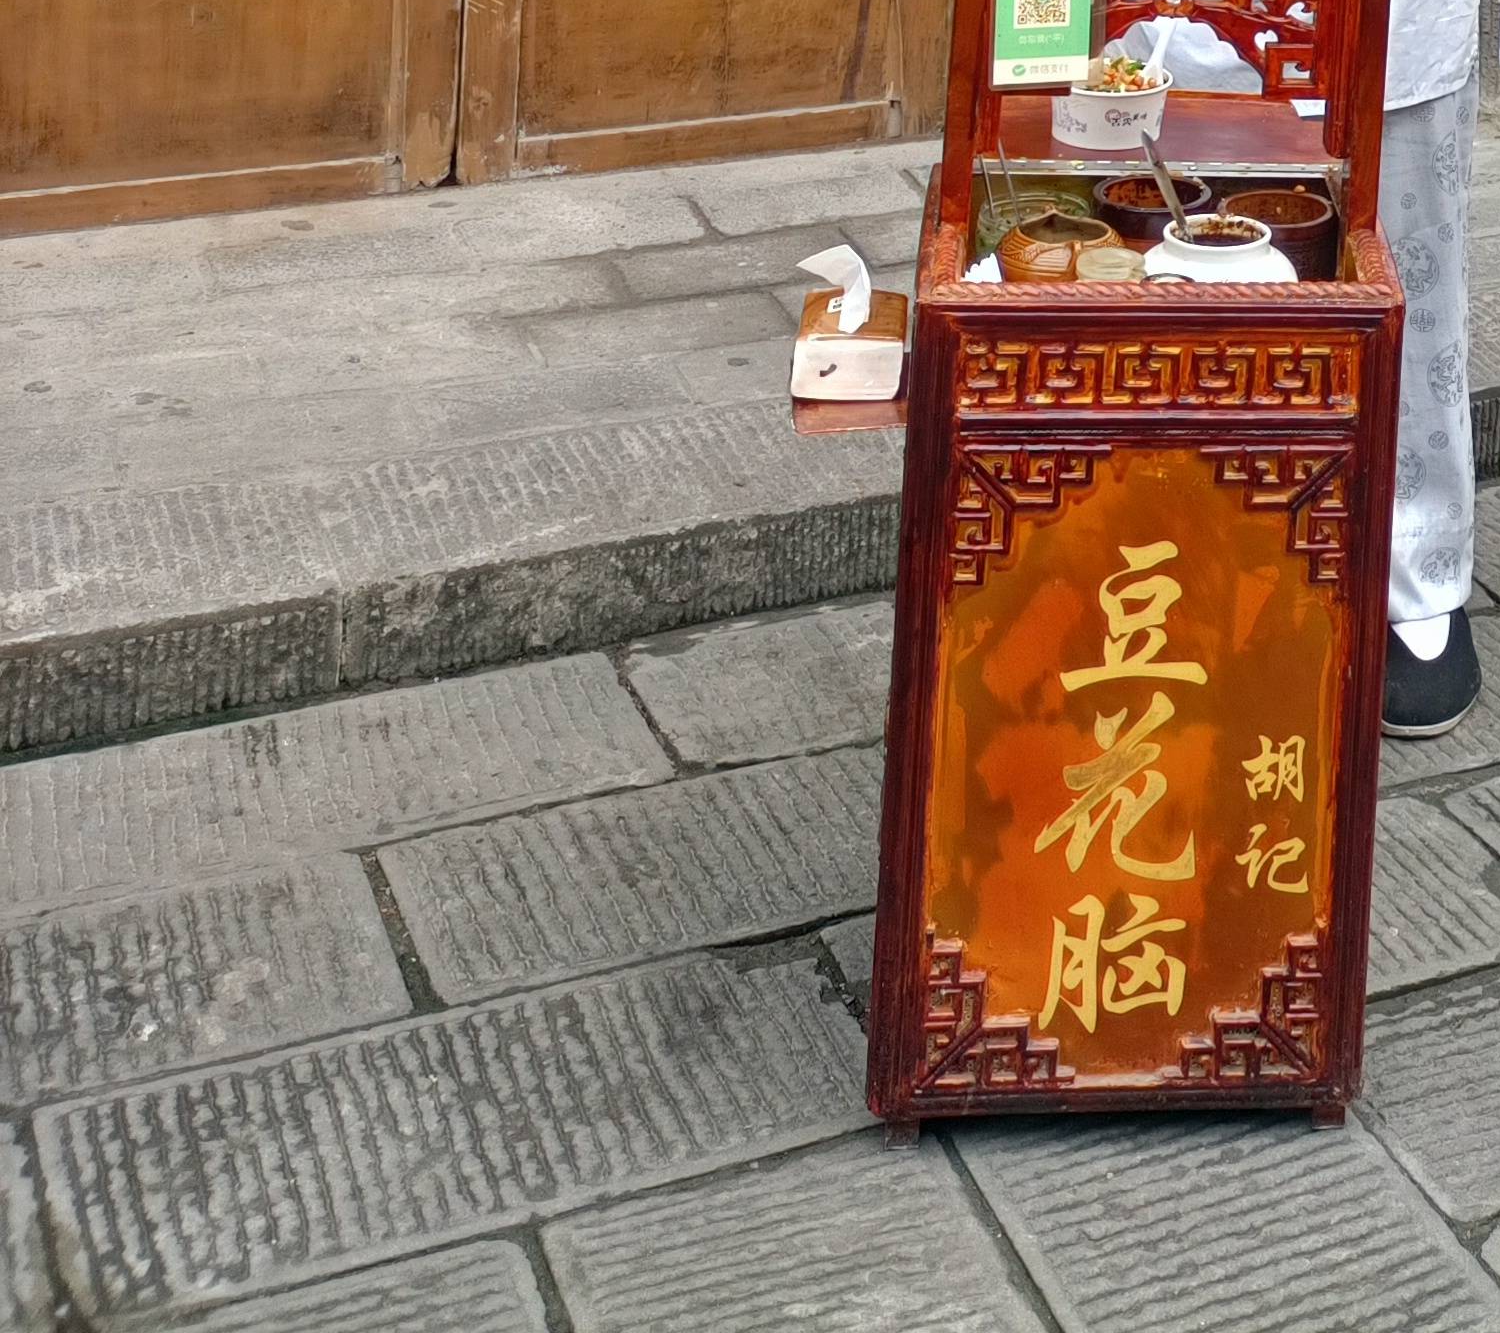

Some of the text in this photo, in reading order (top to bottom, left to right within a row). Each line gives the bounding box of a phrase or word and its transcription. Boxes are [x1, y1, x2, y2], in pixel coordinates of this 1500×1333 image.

[1032, 540, 1209, 1034] 豆花脑
[1234, 734, 1310, 895] 胡记
